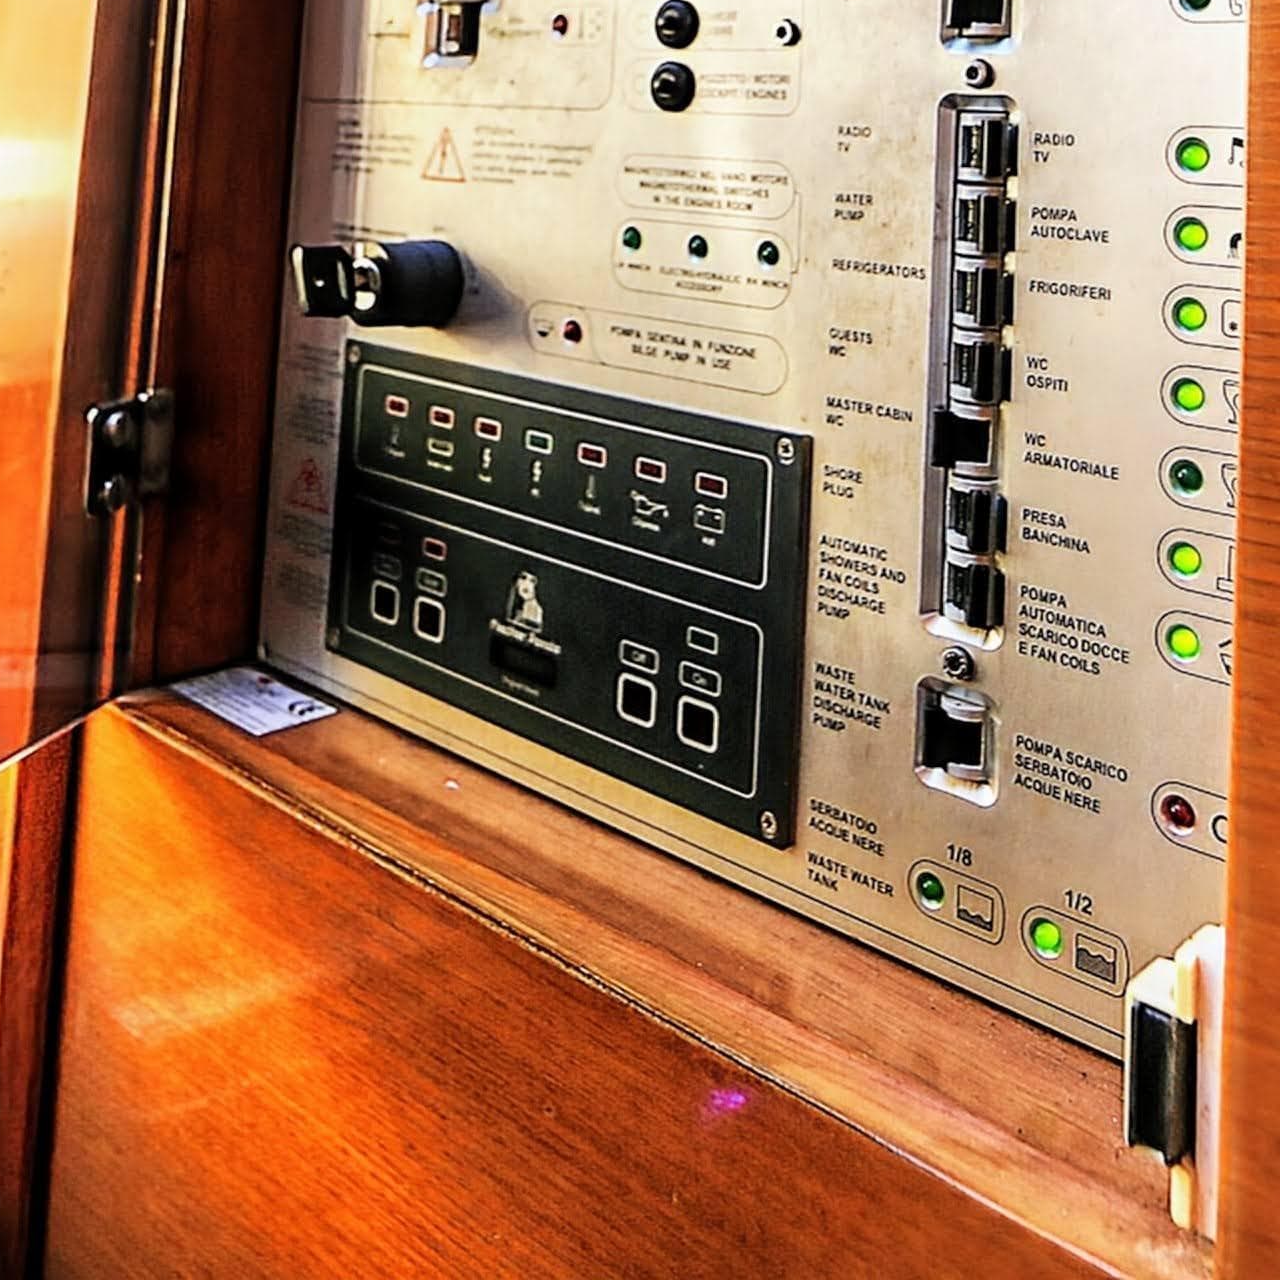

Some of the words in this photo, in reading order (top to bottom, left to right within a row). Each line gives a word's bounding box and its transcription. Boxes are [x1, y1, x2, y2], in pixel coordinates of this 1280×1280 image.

[837, 125, 872, 139] RADIO
[1033, 132, 1076, 148] RADIO
[836, 140, 852, 154] TV
[1032, 150, 1051, 164] TV
[834, 193, 874, 207] WATER
[833, 208, 866, 221] PUMP
[1030, 206, 1079, 222] POMPA
[1030, 225, 1111, 244] AUTOCLAVE
[831, 257, 927, 281] REFRIGERATORS
[1028, 279, 1113, 301] FRIGORIFERI
[610, 325, 642, 340] POMPA
[646, 331, 688, 347] SENTINA
[691, 339, 702, 351] IN
[706, 340, 757, 360] FUNZIONE
[828, 326, 874, 346] GUESTS
[631, 343, 658, 358] BILGE
[662, 350, 690, 363] PUMP
[695, 354, 707, 367] IN
[711, 357, 733, 371] USE
[828, 344, 847, 358] WC
[1025, 355, 1049, 372] WC
[1025, 373, 1070, 394] OSPITI
[825, 413, 845, 428] WC
[826, 395, 874, 417] MASTER
[875, 404, 914, 424] CABIN
[1023, 431, 1048, 448] WC
[823, 464, 864, 485] SHORE
[1023, 450, 1120, 482] ARMATORIALE
[822, 481, 855, 500] PLUG
[1021, 508, 1068, 531] PRESA
[819, 534, 889, 563] AUTOMATIC
[1021, 526, 1092, 555] BANCHINA
[819, 550, 879, 578] SHOWERS
[879, 568, 907, 585] AND
[818, 567, 843, 585] FAN
[844, 574, 881, 595] COILS
[817, 584, 887, 616] DISCHARGE
[1019, 584, 1068, 609] POMPA
[816, 601, 851, 621] PUMP
[1018, 604, 1107, 639] AUTOMATICA
[1018, 622, 1079, 650] SCARICO
[1080, 638, 1131, 665] DOCCE
[1017, 640, 1028, 656] E
[1029, 644, 1058, 664] FAN
[1059, 651, 1101, 676] COILS
[814, 661, 857, 687] WASTE
[813, 678, 857, 704] WATER
[857, 691, 891, 715] TANK
[811, 712, 847, 734] PUMP
[812, 695, 883, 730] DISCHARGE
[1015, 733, 1063, 763] POMPA
[1064, 750, 1129, 783] SCARICO
[1014, 752, 1093, 791] SERBATOIO
[1014, 773, 1062, 801] ACQUE
[1063, 788, 1102, 815] NERE
[809, 798, 878, 835] SERBATOIO
[808, 816, 850, 843] ACQUE
[851, 832, 886, 858] NERE
[946, 842, 974, 868] 1/8
[806, 867, 839, 892] TANK
[807, 850, 848, 879] WASTE
[849, 867, 895, 898] WATER
[1063, 888, 1094, 918] 1/2
